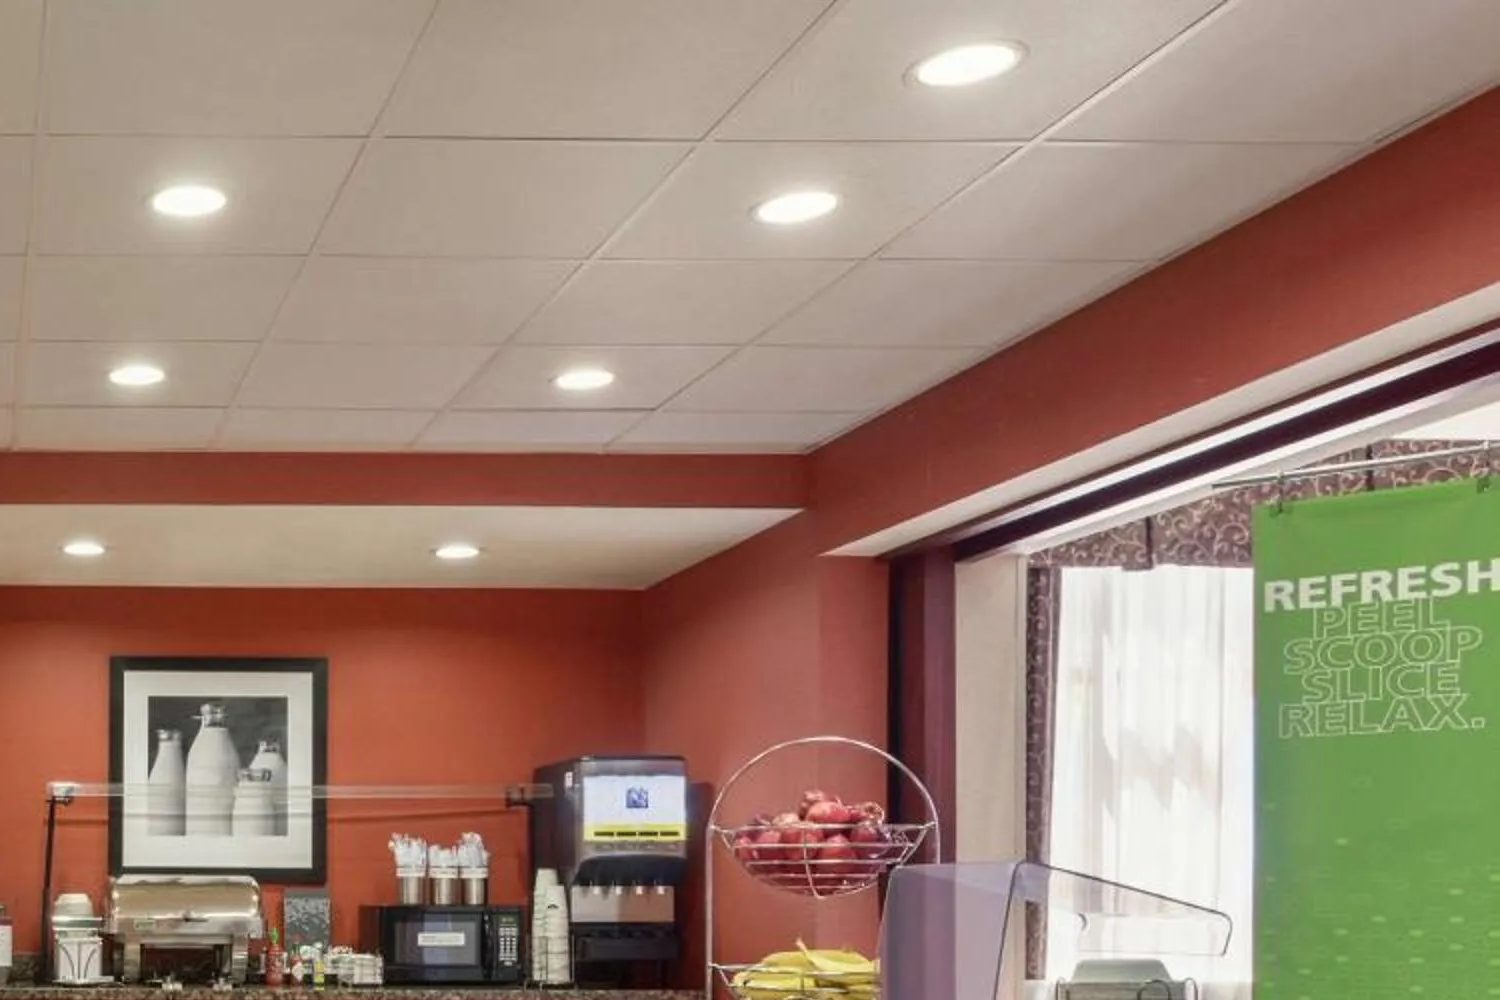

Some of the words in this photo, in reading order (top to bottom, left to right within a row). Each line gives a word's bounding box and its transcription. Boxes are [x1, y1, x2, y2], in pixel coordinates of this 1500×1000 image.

[1263, 558, 1500, 613] REFRESH
[1312, 597, 1451, 640] PEEL
[1283, 625, 1484, 676] SCOOP
[1301, 662, 1461, 704] SLICE
[1278, 693, 1486, 738] RELAX.
